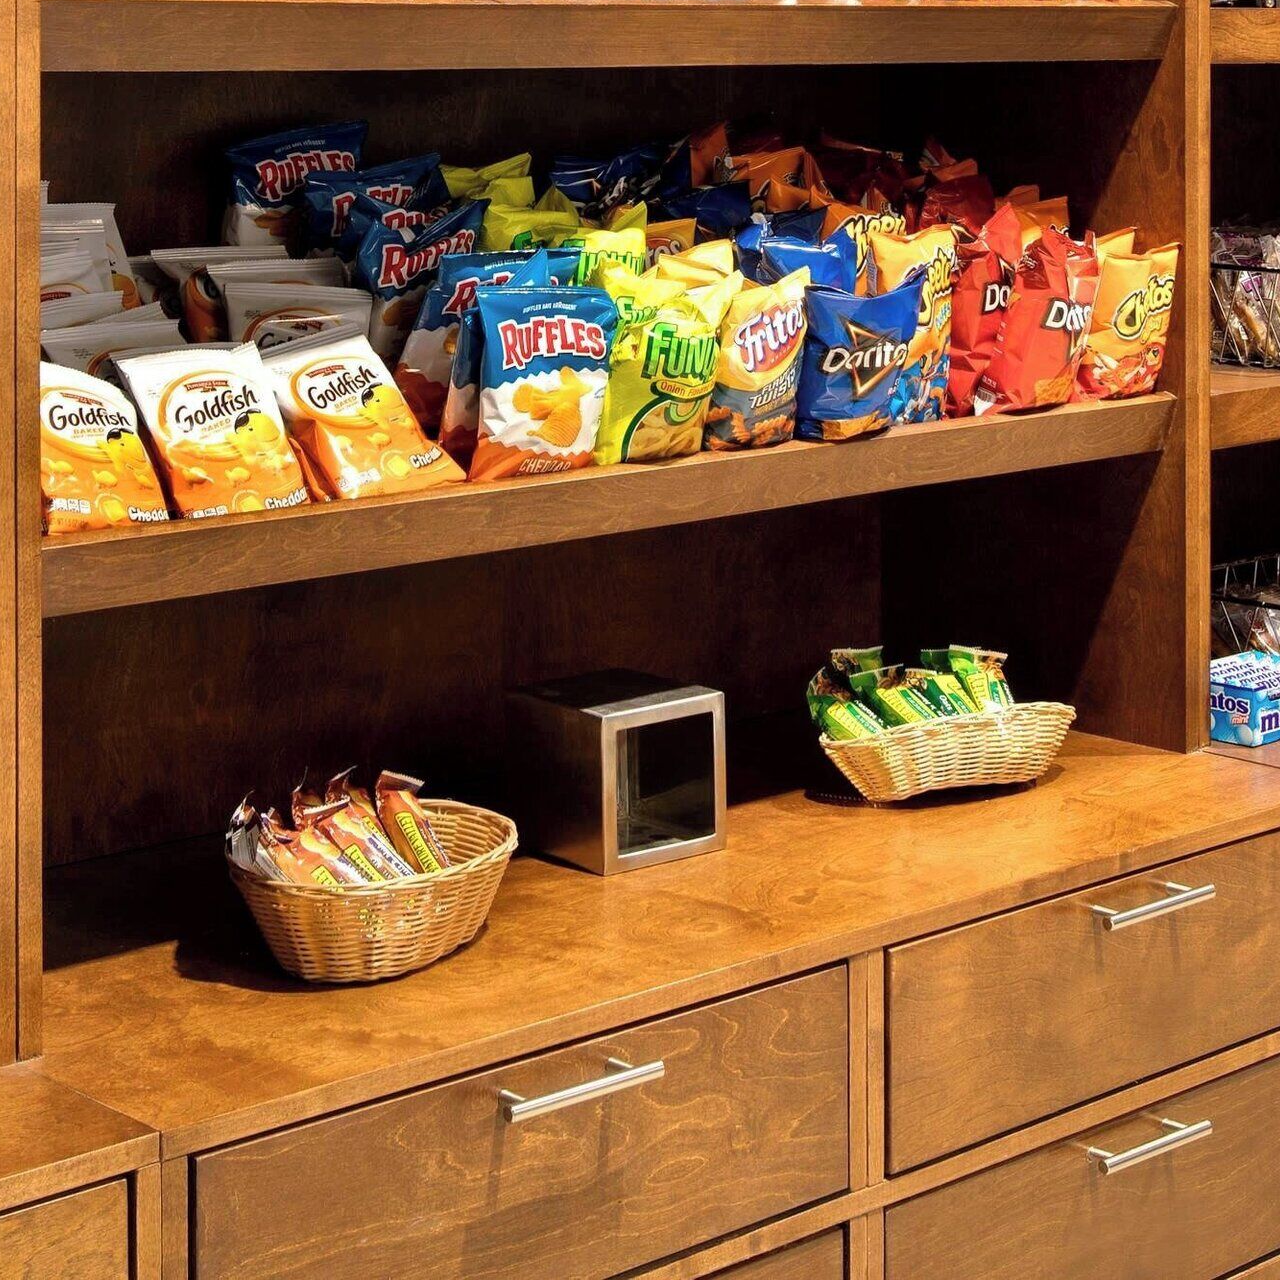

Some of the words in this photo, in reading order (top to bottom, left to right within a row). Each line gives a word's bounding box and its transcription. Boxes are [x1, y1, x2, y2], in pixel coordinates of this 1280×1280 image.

[255, 149, 356, 203] RUFFLES
[379, 228, 478, 290] RUFFLES
[497, 314, 608, 372] RUFFLES
[733, 298, 806, 372] Fritos
[823, 341, 909, 374] Dorito
[307, 364, 380, 410] Goldfish
[334, 395, 358, 410] BAKED
[660, 381, 686, 397] Onion
[48, 404, 132, 432] Goldfish
[174, 384, 262, 434] Goldfish
[73, 426, 106, 436] BAKED
[200, 418, 232, 434] BAKED
[519, 457, 572, 475] CHEDDAR
